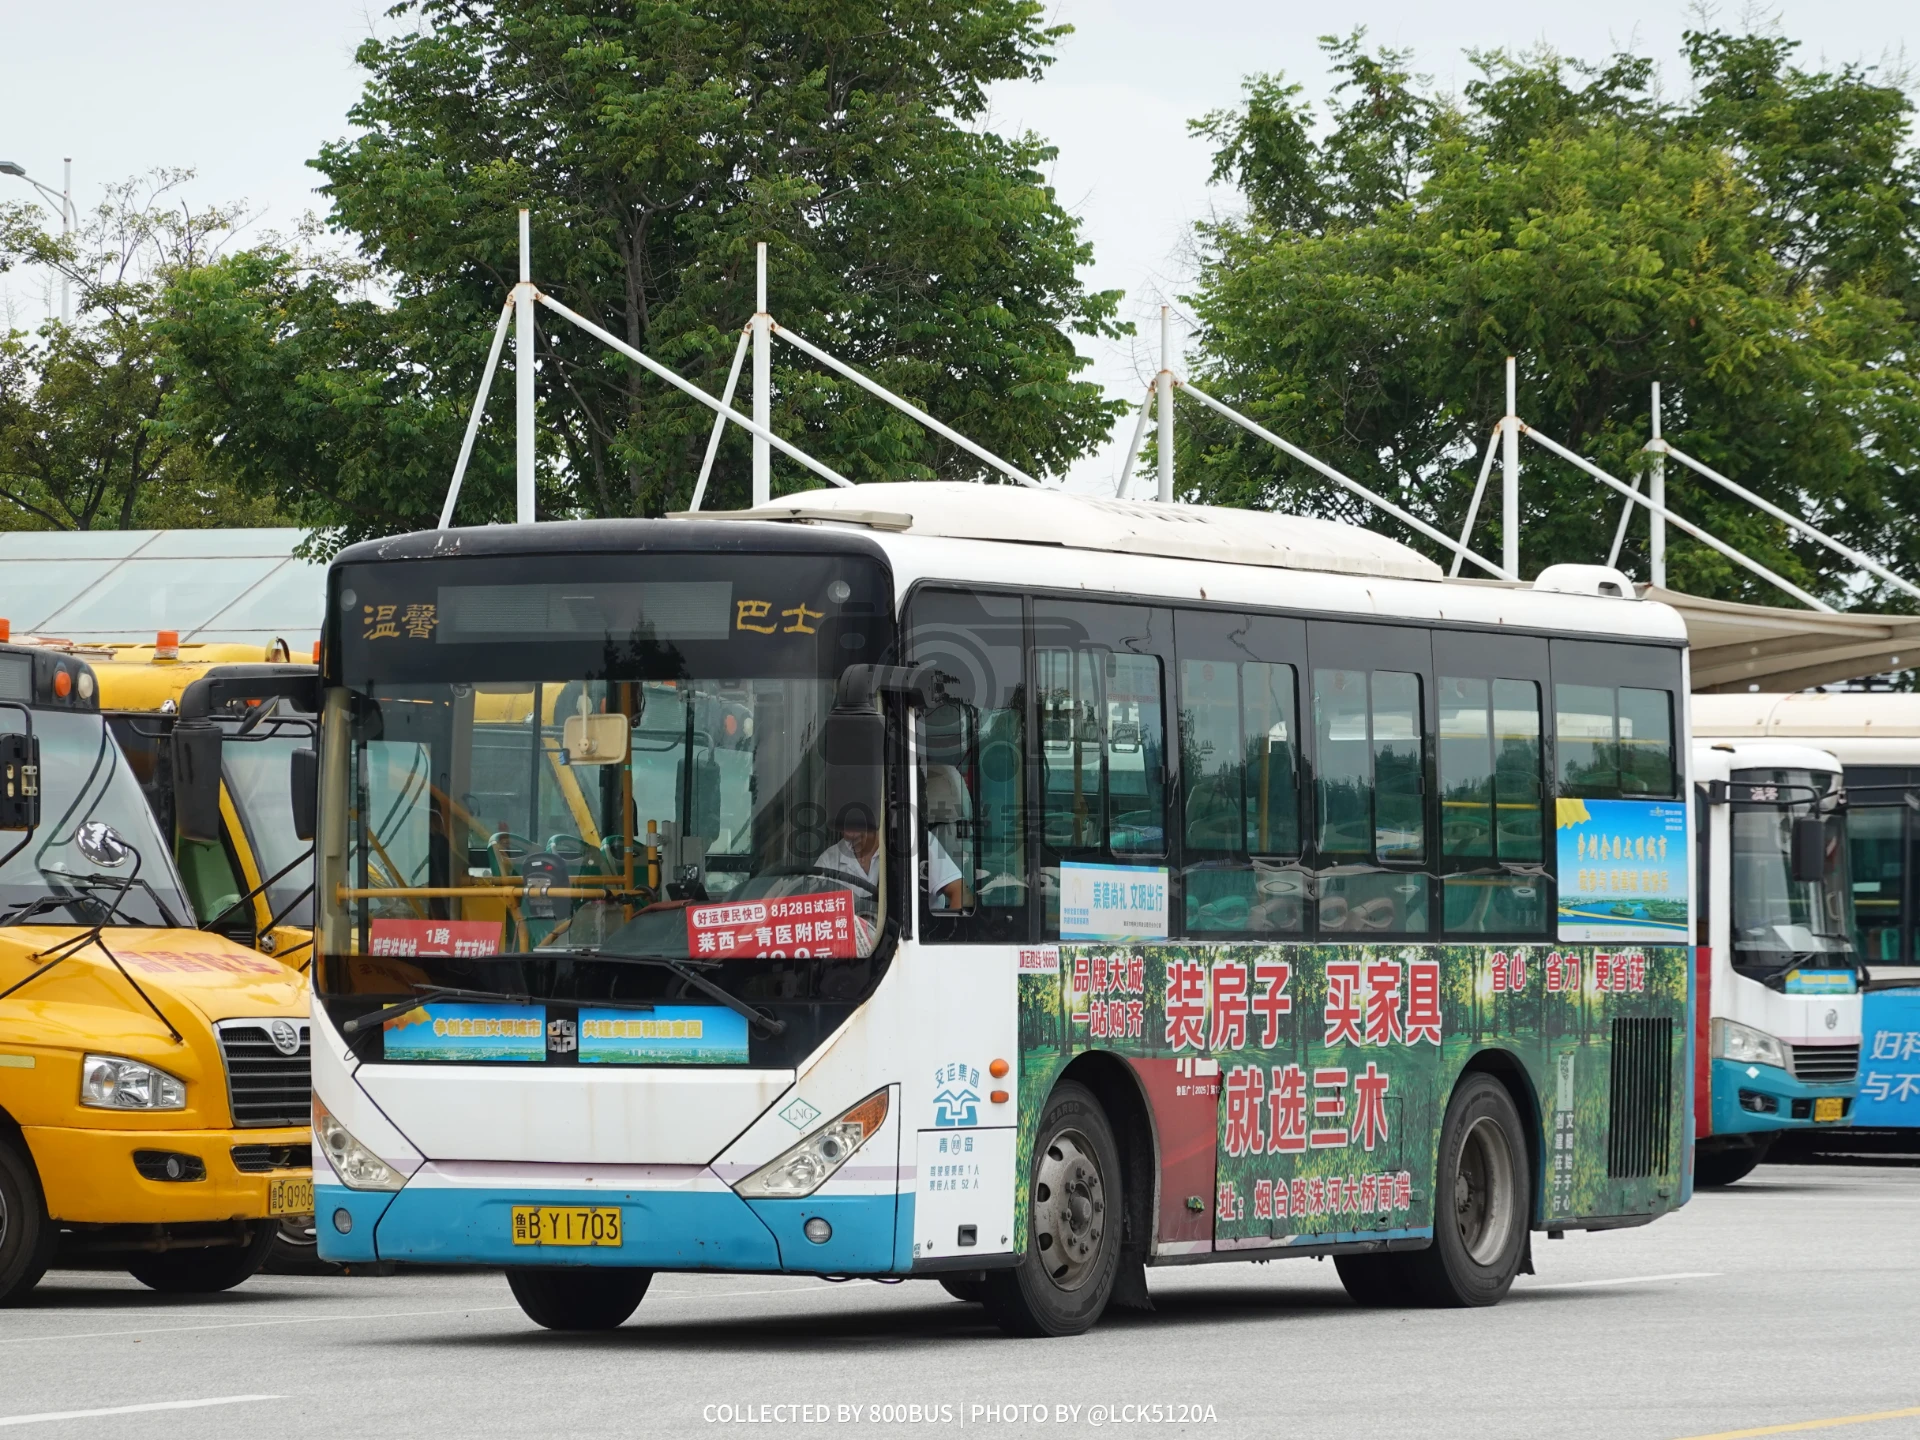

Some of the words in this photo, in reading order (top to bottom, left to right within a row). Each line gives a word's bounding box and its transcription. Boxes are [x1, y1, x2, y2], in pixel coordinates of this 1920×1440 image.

[362, 603, 439, 640] 温馨
[736, 599, 824, 635] 巴士
[697, 906, 764, 925] 好运便民快巴
[771, 898, 846, 918] 8月28日试运行
[1093, 882, 1127, 909] 崇德尚礼
[1130, 884, 1163, 912] 文明出行
[426, 928, 450, 945] 1路
[697, 931, 735, 952] 莱西
[755, 920, 834, 947] 青医附院
[1073, 956, 1143, 993] 品牌大城
[1491, 951, 1526, 993] 省心
[1546, 952, 1581, 993] 省力
[1595, 953, 1646, 993] 更省钱
[1072, 1000, 1144, 1038] 一站购齐
[1165, 959, 1292, 1052] 装房子
[1324, 958, 1443, 1047] 买家具
[433, 1018, 542, 1038] 争创全国文明城市
[582, 1019, 703, 1039] 共建美丽和谐家园
[935, 1063, 980, 1088] 交运集团
[788, 1107, 812, 1120] LNG
[1224, 1061, 1390, 1157] 就选三木
[1255, 1173, 1410, 1218] 烟台路洙河大桥南端
[515, 1212, 618, 1240] 鲁B·Y1703
